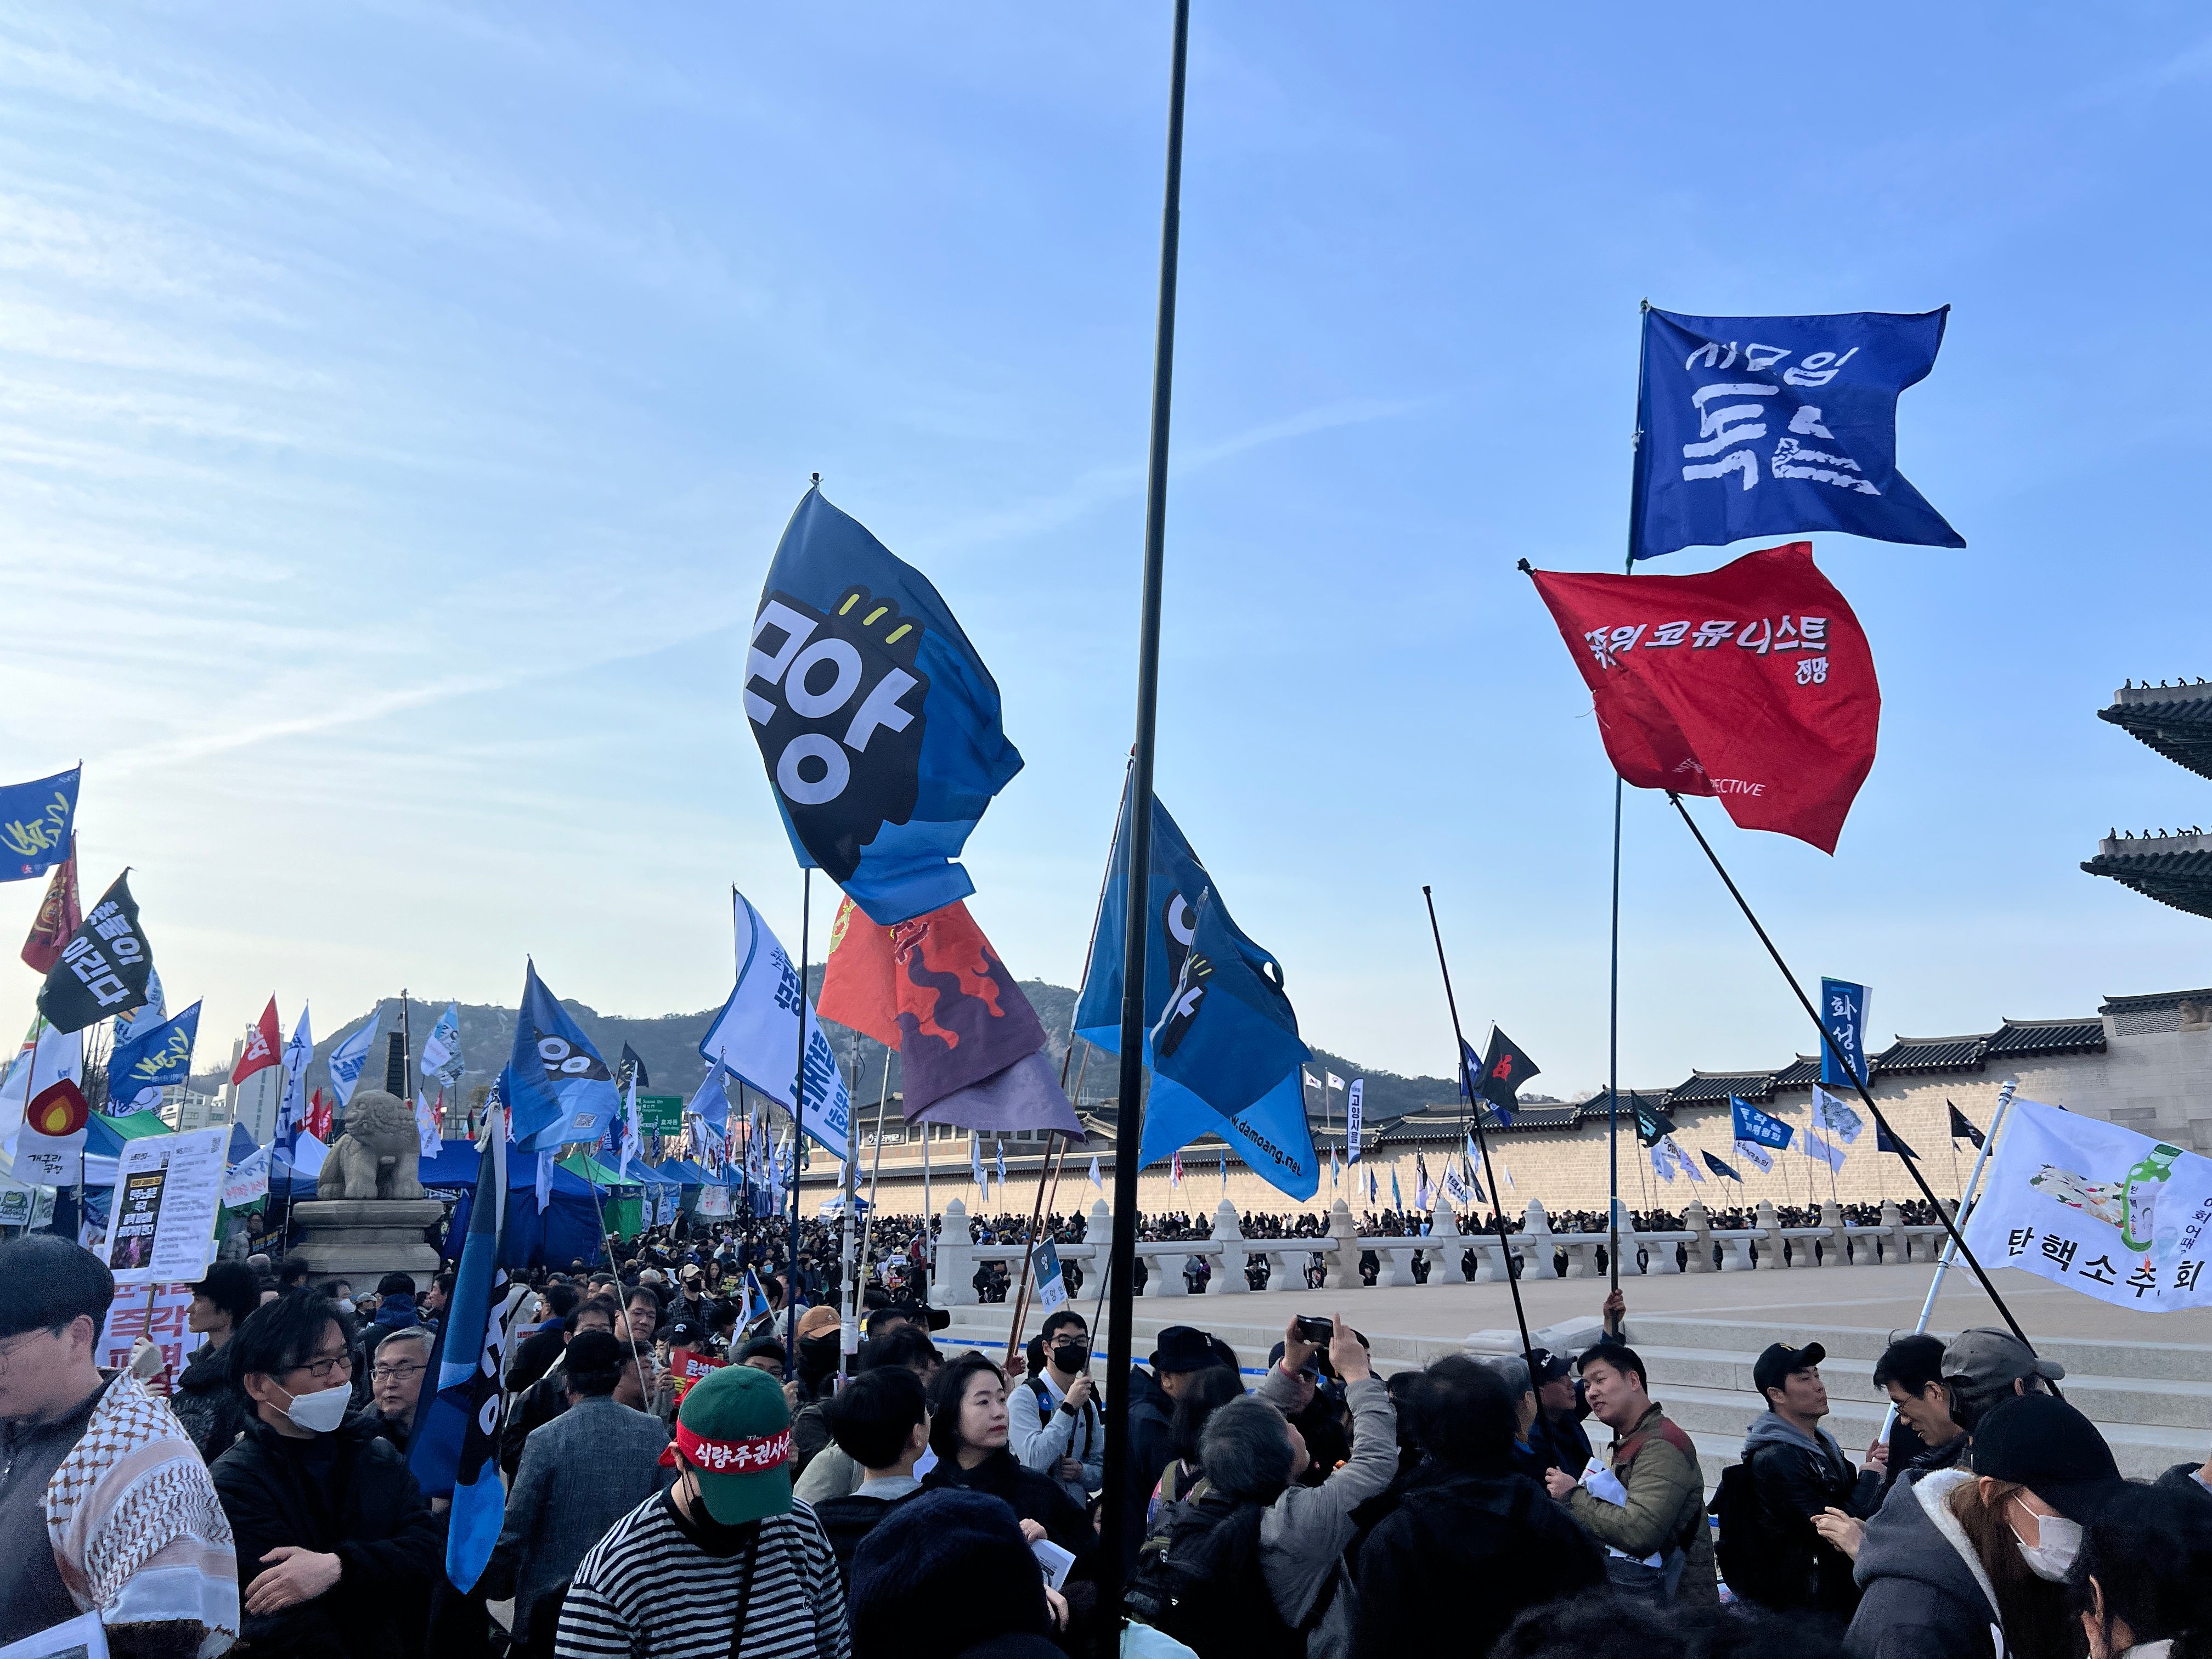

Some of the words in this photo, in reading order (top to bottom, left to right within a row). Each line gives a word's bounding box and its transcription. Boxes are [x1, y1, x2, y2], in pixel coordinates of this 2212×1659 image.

[1645, 615, 1827, 654] 코뮤니스트
[1795, 657, 1829, 685] 전망
[88, 901, 143, 966] 촛불이
[61, 936, 131, 1007] 이긴다
[1351, 1094, 1360, 1143] 고양시을
[27, 1154, 61, 1164] 개구리
[111, 1305, 188, 1338] 즉각
